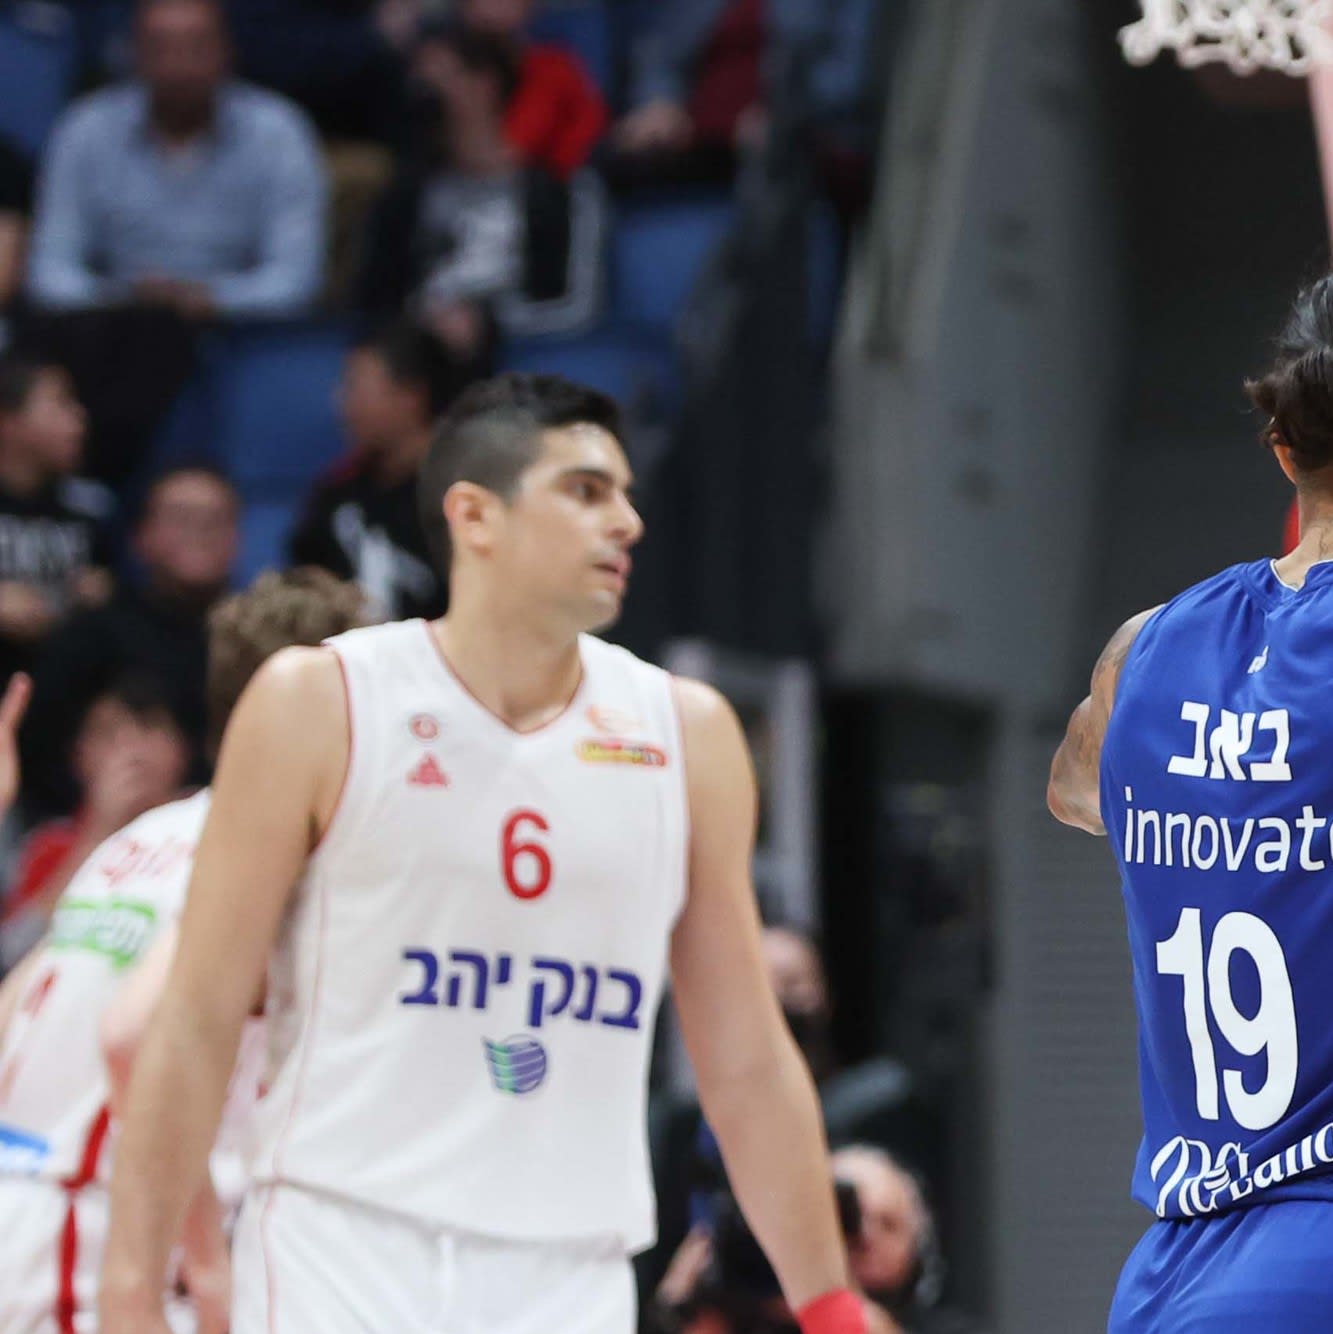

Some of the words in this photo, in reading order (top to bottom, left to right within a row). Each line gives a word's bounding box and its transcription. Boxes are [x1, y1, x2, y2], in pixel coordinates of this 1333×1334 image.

[1166, 700, 1293, 782] באב
[500, 807, 555, 902] 6
[399, 948, 512, 1011] יהב
[526, 956, 645, 1031] בנק
[1155, 906, 1299, 1132] 19
